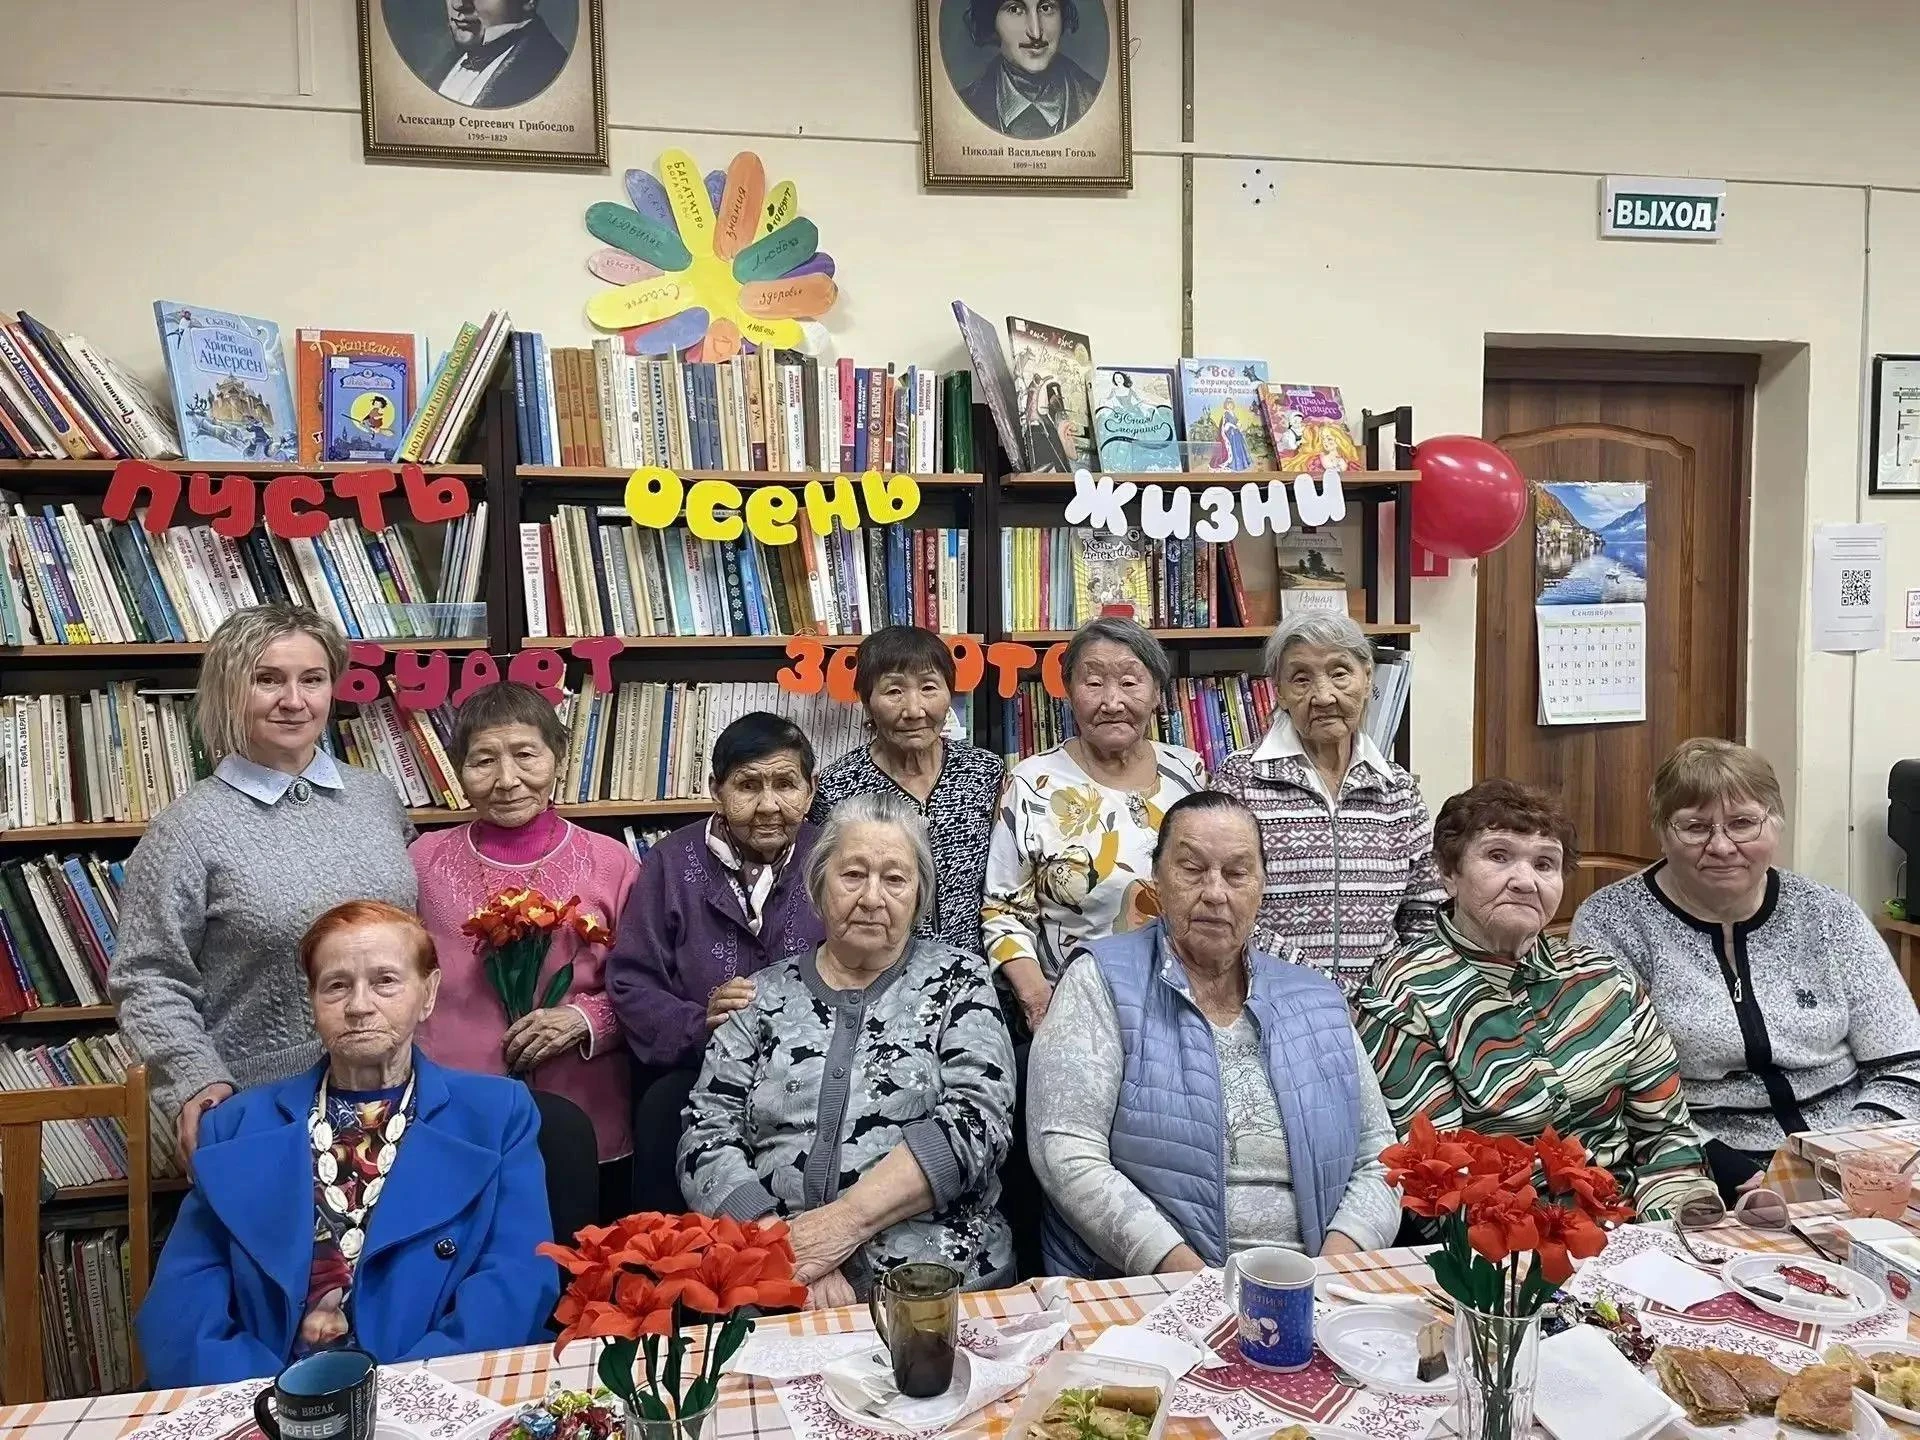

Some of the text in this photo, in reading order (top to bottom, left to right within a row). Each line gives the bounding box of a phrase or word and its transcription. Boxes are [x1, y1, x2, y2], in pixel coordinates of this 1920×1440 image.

[397, 114, 575, 132] Александр Сергеевич Грибоедов
[962, 146, 1097, 159] Николай Васильевич Гоголь
[1616, 199, 1713, 230] ВЫХОД
[216, 331, 235, 342] Ганс
[204, 338, 253, 357] Христиан
[200, 349, 263, 373] Андерсен
[872, 371, 881, 385] КИР
[1208, 366, 1235, 377] Всё
[404, 404, 438, 456] БОЛЬШАЯ
[431, 370, 454, 403] КНИГА
[529, 578, 537, 597] ВОЛКОВ
[833, 550, 850, 627] Борис Житков
[531, 598, 540, 625] АЛЕКСАНДР
[1571, 608, 1613, 617] Сентябрь
[627, 687, 637, 770] ВЛАДИСЛАВ КРАПИВИН
[18, 710, 27, 767] РЕБЯТА ЗВЕРЯТА
[379, 702, 415, 777] ПИТОМЦЫ ЗООПАРКА
[301, 1402, 335, 1417] BREAK
